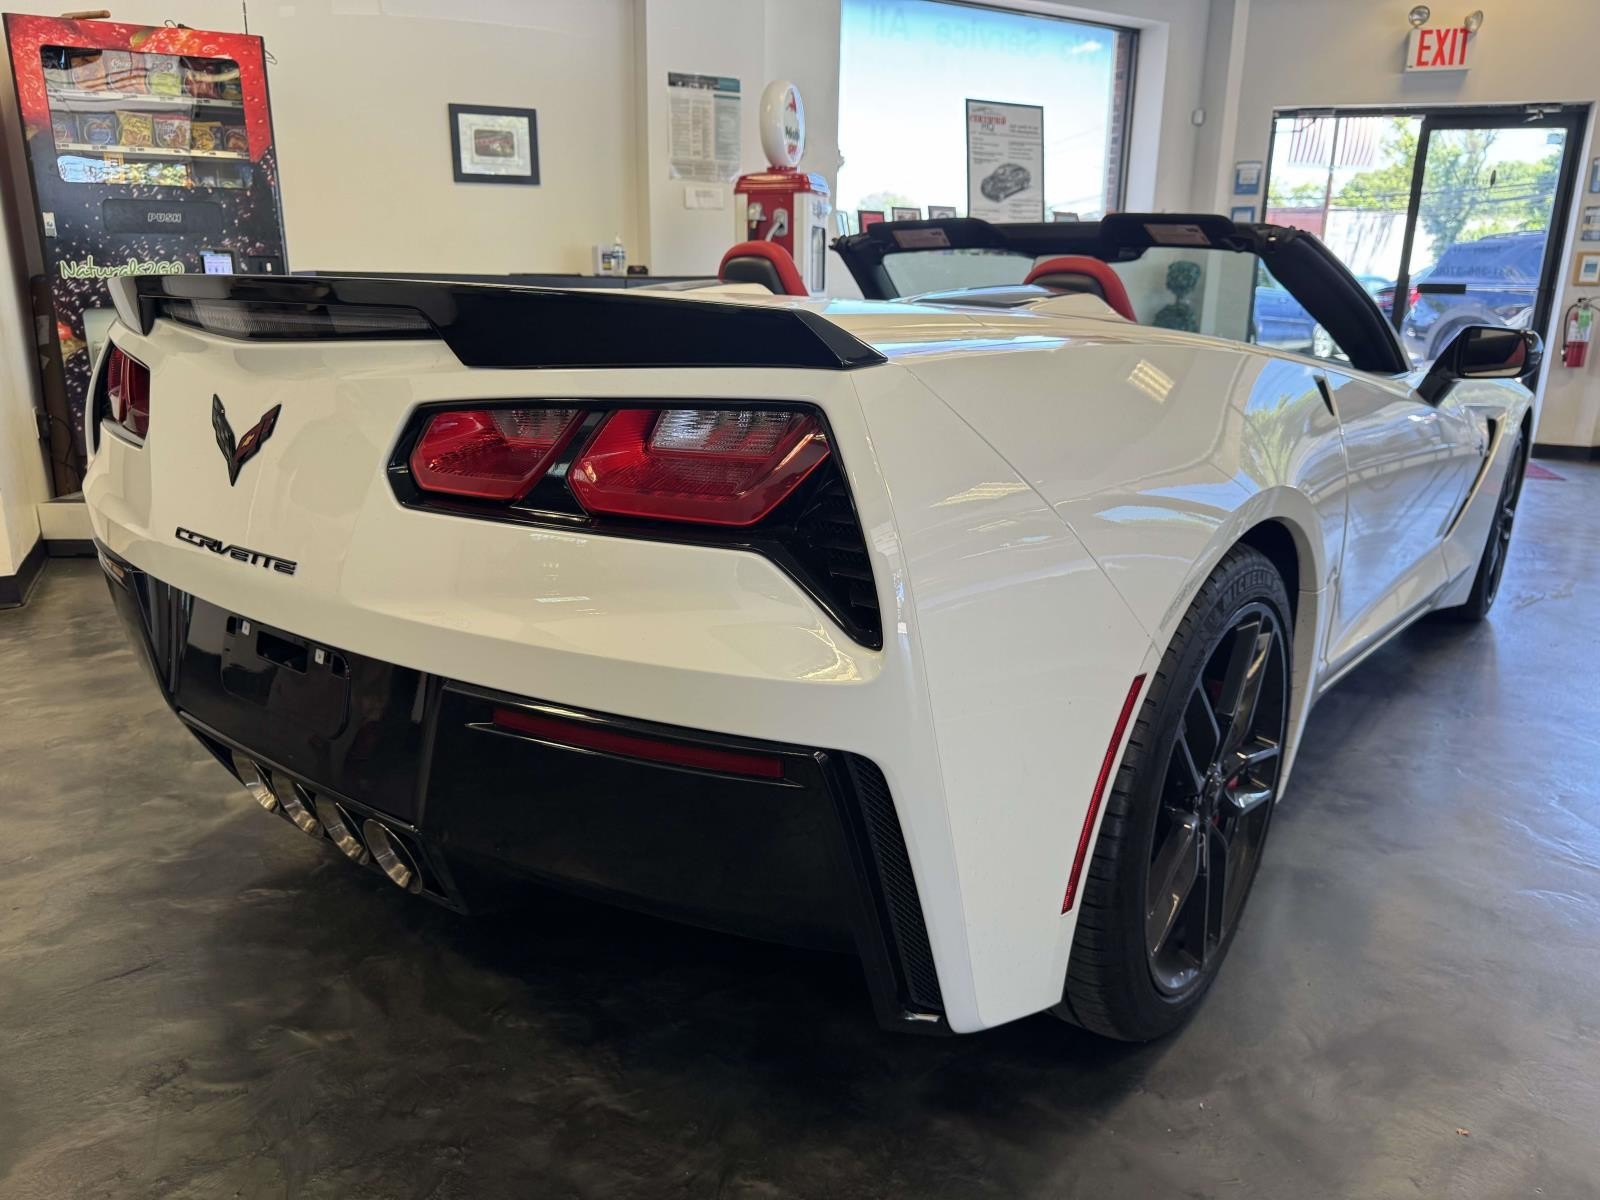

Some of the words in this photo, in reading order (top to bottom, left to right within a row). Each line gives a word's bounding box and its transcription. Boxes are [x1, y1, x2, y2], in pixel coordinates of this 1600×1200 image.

[1415, 27, 1472, 66] EXIT
[147, 212, 182, 223] PUSH
[175, 526, 298, 575] CORVETTE
